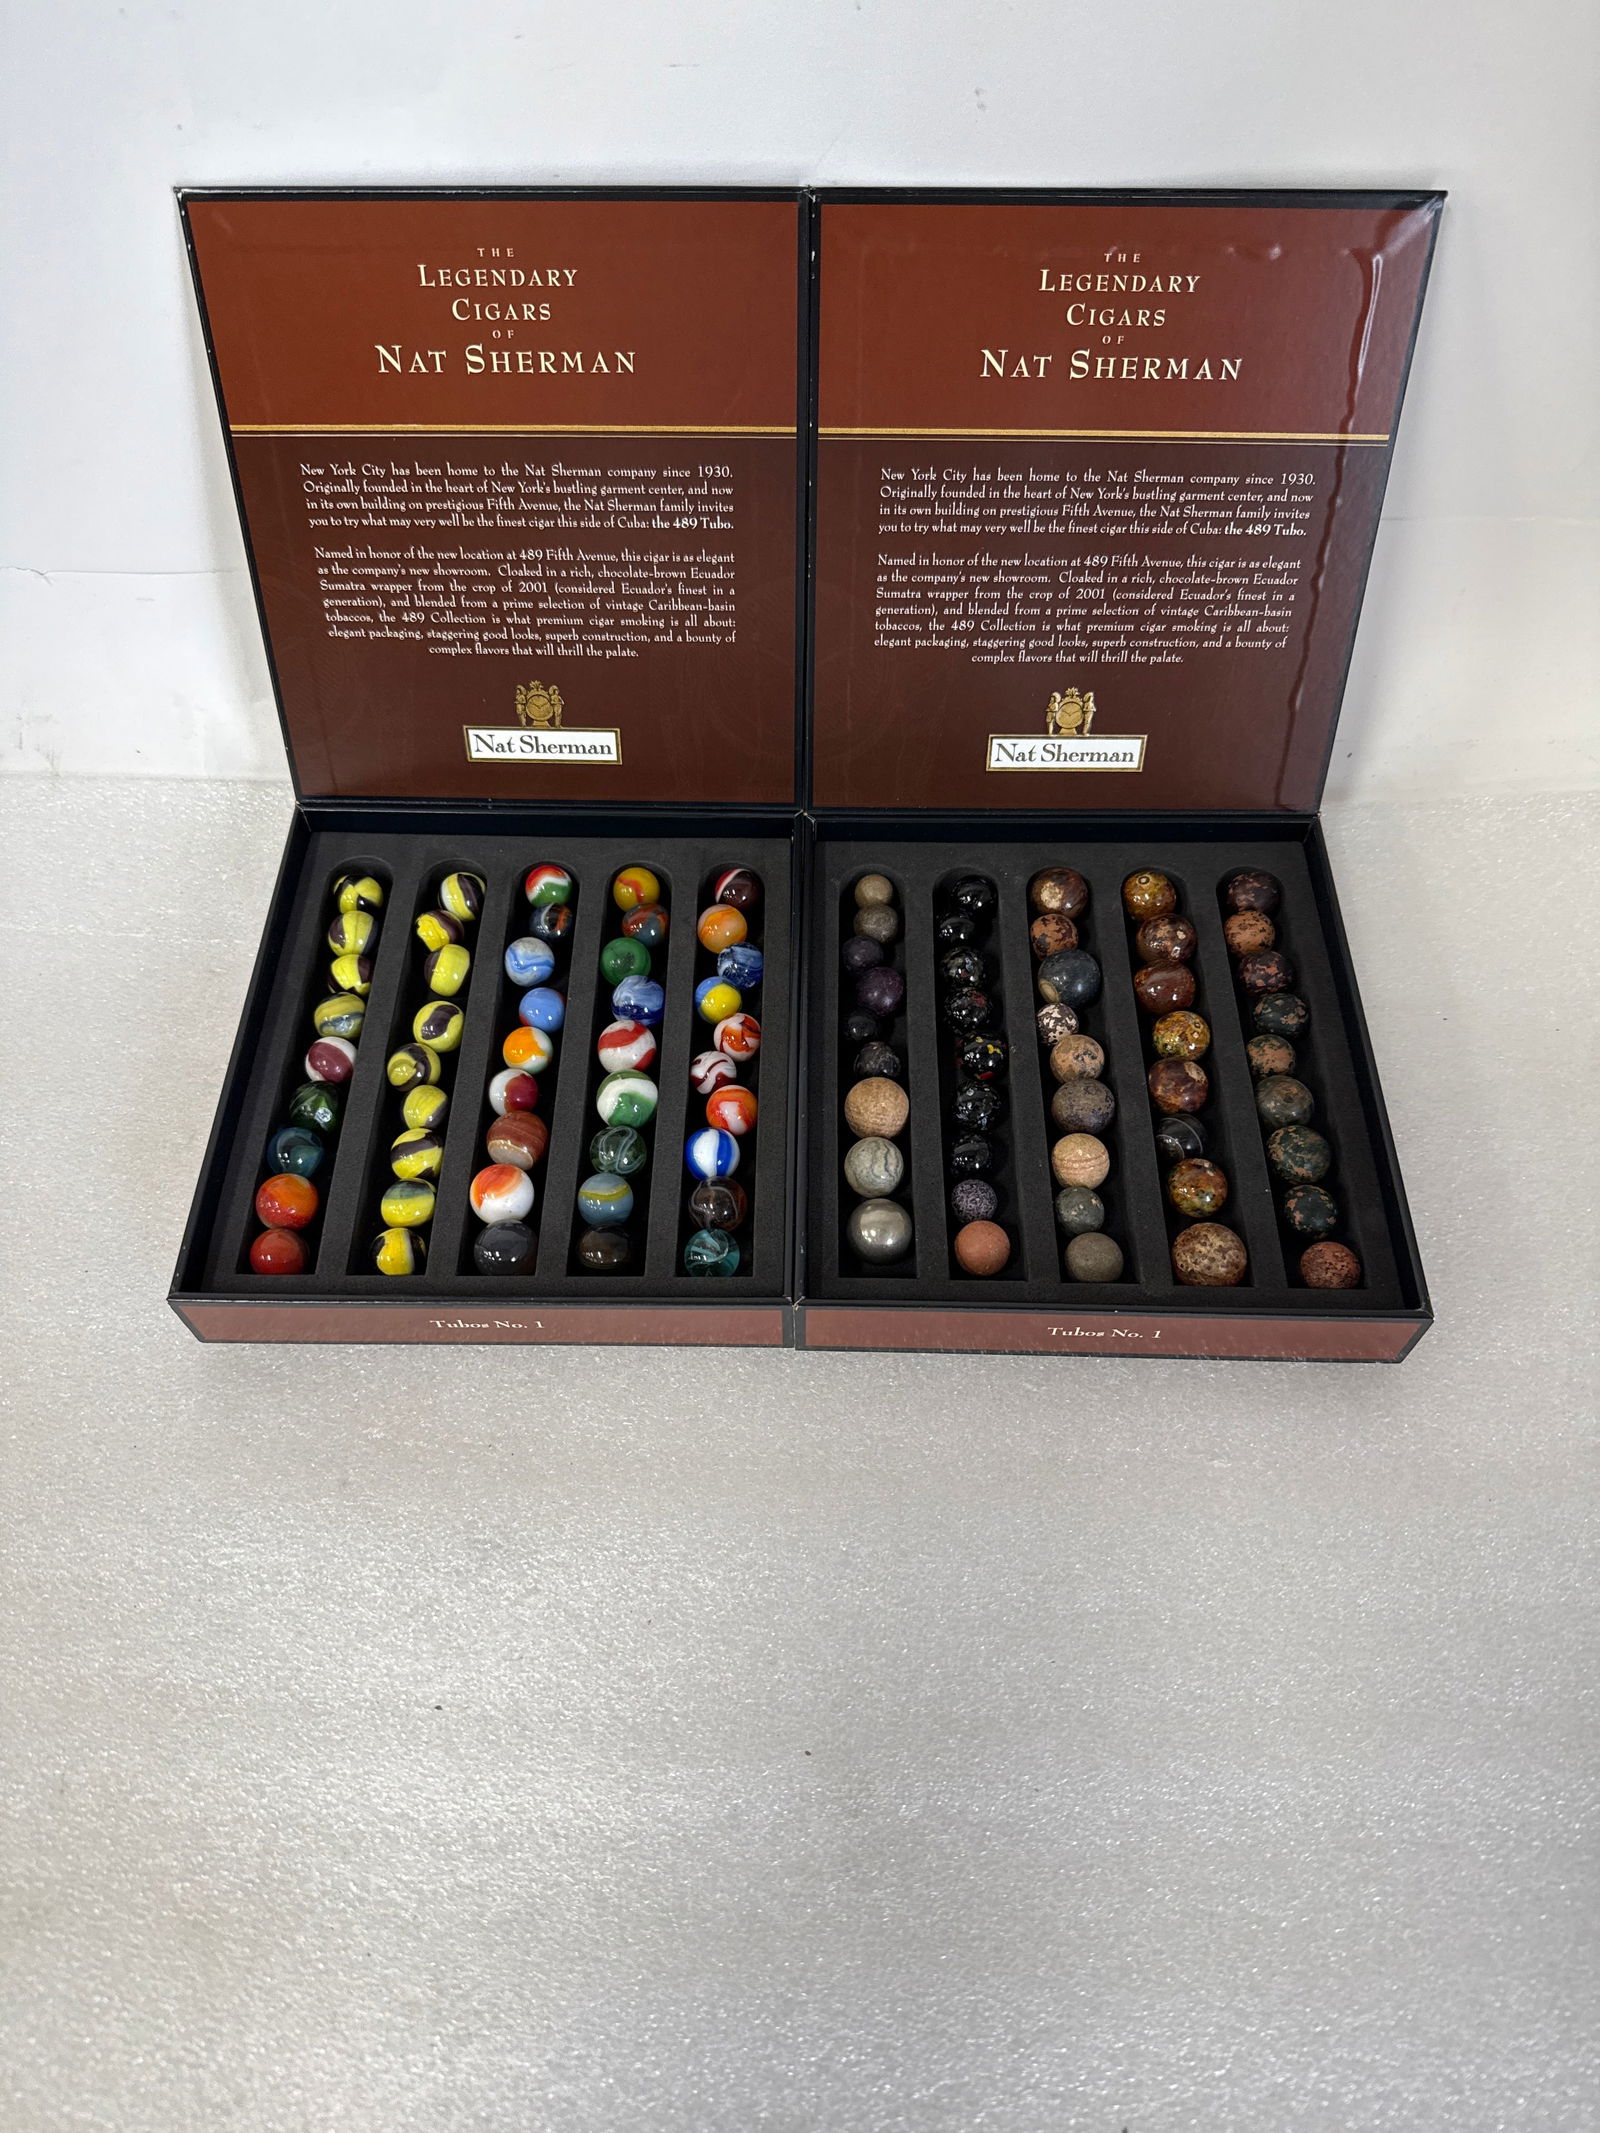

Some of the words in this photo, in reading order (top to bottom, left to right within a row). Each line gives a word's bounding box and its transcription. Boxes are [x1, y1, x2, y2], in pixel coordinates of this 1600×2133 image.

[477, 248, 514, 257] THE
[1104, 253, 1141, 263] THE
[417, 264, 578, 287] LEGENDARY
[1039, 269, 1200, 292] LEGENDARY
[452, 298, 551, 321] CIGARS
[1066, 303, 1166, 327] CIGARS
[492, 330, 515, 338] OF
[1102, 336, 1125, 344] OF
[375, 345, 447, 373] NAT
[465, 343, 635, 374] SHERMAN
[980, 349, 1052, 377] NAT
[1069, 348, 1242, 380] SHERMAN
[300, 464, 325, 476] New
[330, 462, 357, 476] York
[362, 464, 386, 479] City
[391, 462, 411, 476] has
[415, 462, 442, 476] been
[447, 462, 478, 476] home
[484, 466, 496, 476] to
[502, 463, 519, 476] the
[525, 464, 546, 477] Nat
[552, 462, 602, 477] Sherman
[608, 470, 657, 480] company
[663, 467, 691, 478] since
[699, 466, 733, 479] 1930.
[881, 468, 905, 481] New
[912, 467, 937, 481] York
[943, 469, 967, 484] City
[973, 467, 992, 482] has
[998, 467, 1023, 482] been
[1029, 468, 1060, 482] home
[1066, 472, 1078, 482] to
[1084, 469, 1101, 482] the
[1107, 471, 1128, 483] Nat
[1134, 469, 1184, 483] Sherman
[1190, 477, 1240, 487] company
[1246, 474, 1274, 485] since
[1281, 474, 1316, 486] 1930.
[303, 479, 360, 496] Originally
[363, 479, 409, 493] founded
[411, 482, 423, 493] in
[425, 479, 443, 493] the
[445, 480, 474, 494] heart
[477, 480, 488, 493] of
[491, 481, 515, 494] New
[518, 480, 551, 494] York's
[553, 480, 598, 497] bustling
[601, 485, 646, 497] garment
[649, 485, 685, 497] center,
[688, 481, 708, 495] and
[880, 484, 937, 501] Originally
[941, 484, 986, 499] founded
[989, 488, 1000, 499] in
[1004, 485, 1021, 499] the
[1024, 485, 1052, 499] heart
[1055, 485, 1067, 499] of
[1070, 488, 1094, 500] New
[1098, 486, 1130, 500] York's
[1133, 486, 1177, 504] bustling
[1179, 492, 1225, 503] garment
[1228, 492, 1264, 503] center,
[1267, 489, 1289, 502] and
[306, 499, 318, 510] in
[320, 499, 334, 510] its
[360, 496, 407, 513] building
[426, 500, 484, 513] prestigious
[487, 497, 515, 511] Fifth
[519, 498, 561, 512] Avenue,
[564, 497, 581, 511] the
[584, 499, 605, 511] Nat
[607, 498, 657, 512] Sherman
[660, 498, 695, 515] family
[698, 502, 734, 513] invites
[880, 505, 891, 515] in
[894, 505, 907, 515] its
[935, 502, 980, 519] building
[1000, 506, 1059, 519] prestigious
[1062, 503, 1090, 517] Fifth
[1093, 505, 1136, 519] Avenue,
[1140, 504, 1157, 517] the
[1160, 506, 1180, 518] Nat
[1183, 504, 1233, 518] Sherman
[1236, 505, 1271, 521] family
[1274, 509, 1311, 520] invites
[309, 519, 329, 529] you
[330, 517, 342, 526] to
[344, 517, 359, 529] try
[361, 513, 387, 527] what
[389, 519, 412, 529] may
[414, 519, 436, 529] very
[439, 513, 460, 527] well
[461, 514, 475, 527] be
[477, 514, 494, 527] the
[497, 514, 527, 528] finest
[529, 517, 555, 530] cigar
[558, 514, 578, 528] this
[580, 514, 601, 528] side
[604, 515, 615, 528] of
[618, 515, 650, 529] Cuba:
[652, 515, 670, 529] the
[673, 518, 698, 530] 489
[700, 516, 734, 530] Tubo.
[879, 525, 898, 535] you
[901, 523, 912, 532] to
[915, 523, 929, 535] try
[932, 519, 957, 533] what
[960, 526, 982, 536] may
[985, 526, 1007, 536] very
[1010, 520, 1031, 533] well
[1033, 520, 1046, 533] be
[1049, 520, 1066, 534] the
[1069, 520, 1098, 534] finest
[1100, 523, 1127, 537] cigar
[1130, 520, 1150, 534] this
[1152, 521, 1174, 534] side
[1176, 521, 1189, 535] of
[1190, 521, 1222, 535] Cuba:
[1225, 522, 1243, 535] the
[1246, 524, 1272, 537] 489
[1274, 523, 1307, 536] Tubo.
[429, 642, 473, 657] complex
[475, 642, 510, 655] flavors
[512, 643, 533, 656] that
[536, 643, 555, 656] will
[557, 644, 584, 656] thrill
[587, 644, 603, 657] the
[606, 645, 639, 659] palate.
[972, 650, 1015, 665] complex
[1018, 650, 1053, 663] flavors
[1056, 650, 1076, 663] that
[1080, 650, 1099, 663] will
[1102, 650, 1129, 663] thrill
[1131, 651, 1147, 663] the
[1150, 651, 1184, 666] palate.
[473, 734, 515, 753] Nat
[519, 735, 613, 755] Sherman
[994, 743, 1036, 762] Nat
[1041, 743, 1135, 762] Sherman
[430, 1320, 489, 1328] Tubos
[494, 1320, 527, 1328] No.
[1048, 1327, 1104, 1336] Tubos
[1111, 1329, 1143, 1337] No.
[1152, 1330, 1160, 1338] 1
